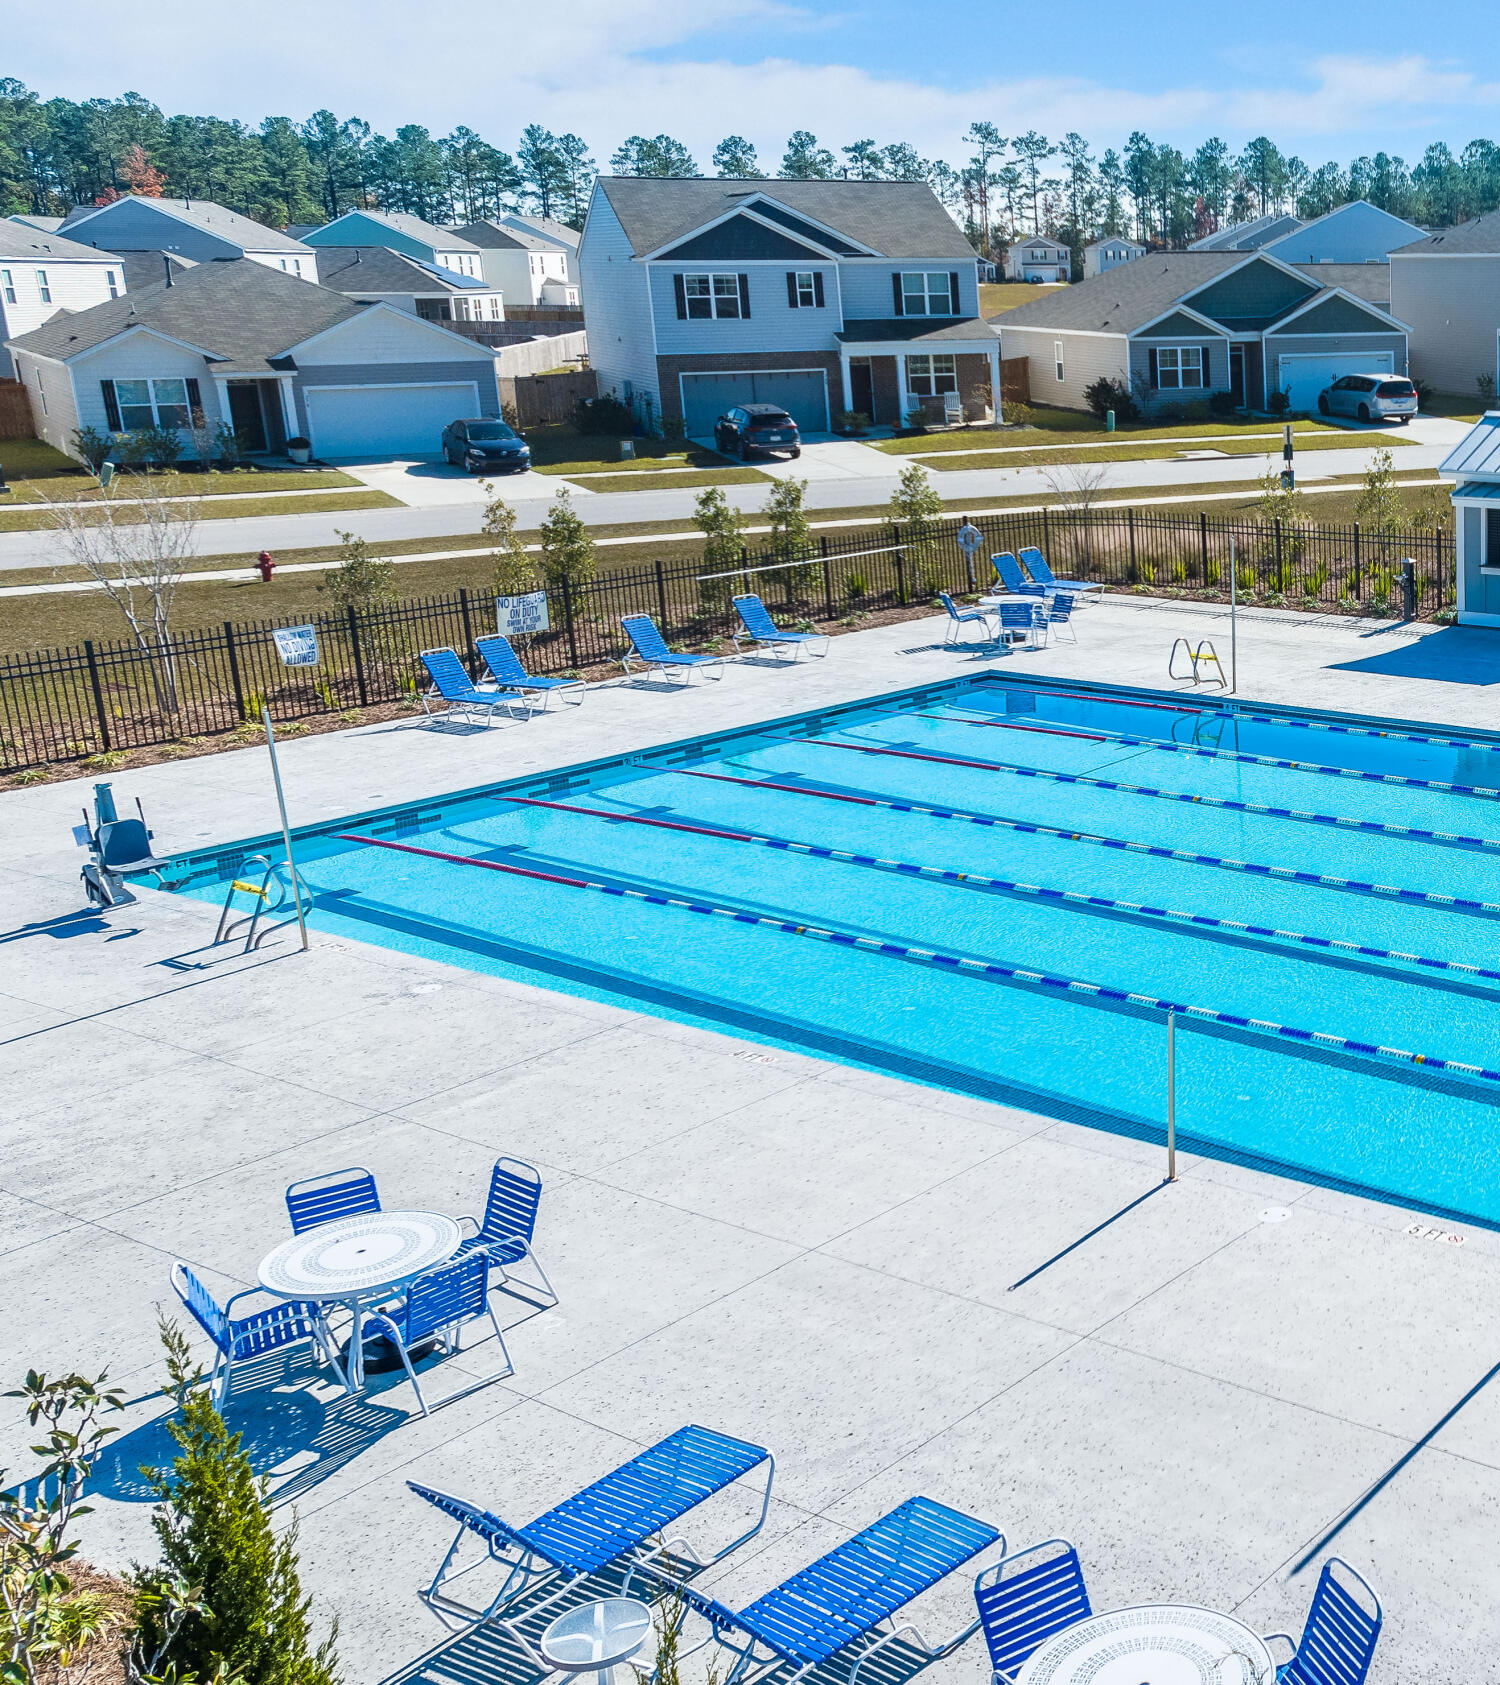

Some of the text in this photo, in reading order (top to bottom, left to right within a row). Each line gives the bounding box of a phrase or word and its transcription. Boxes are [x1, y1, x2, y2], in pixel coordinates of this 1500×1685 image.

[497, 592, 546, 609] NO LIFEGUARD
[510, 605, 538, 619] ON DUTY
[506, 619, 521, 628] SWIM
[512, 625, 525, 634] OWN
[285, 650, 316, 665] ALLOWED
[1408, 1224, 1447, 1241] 5 FT
